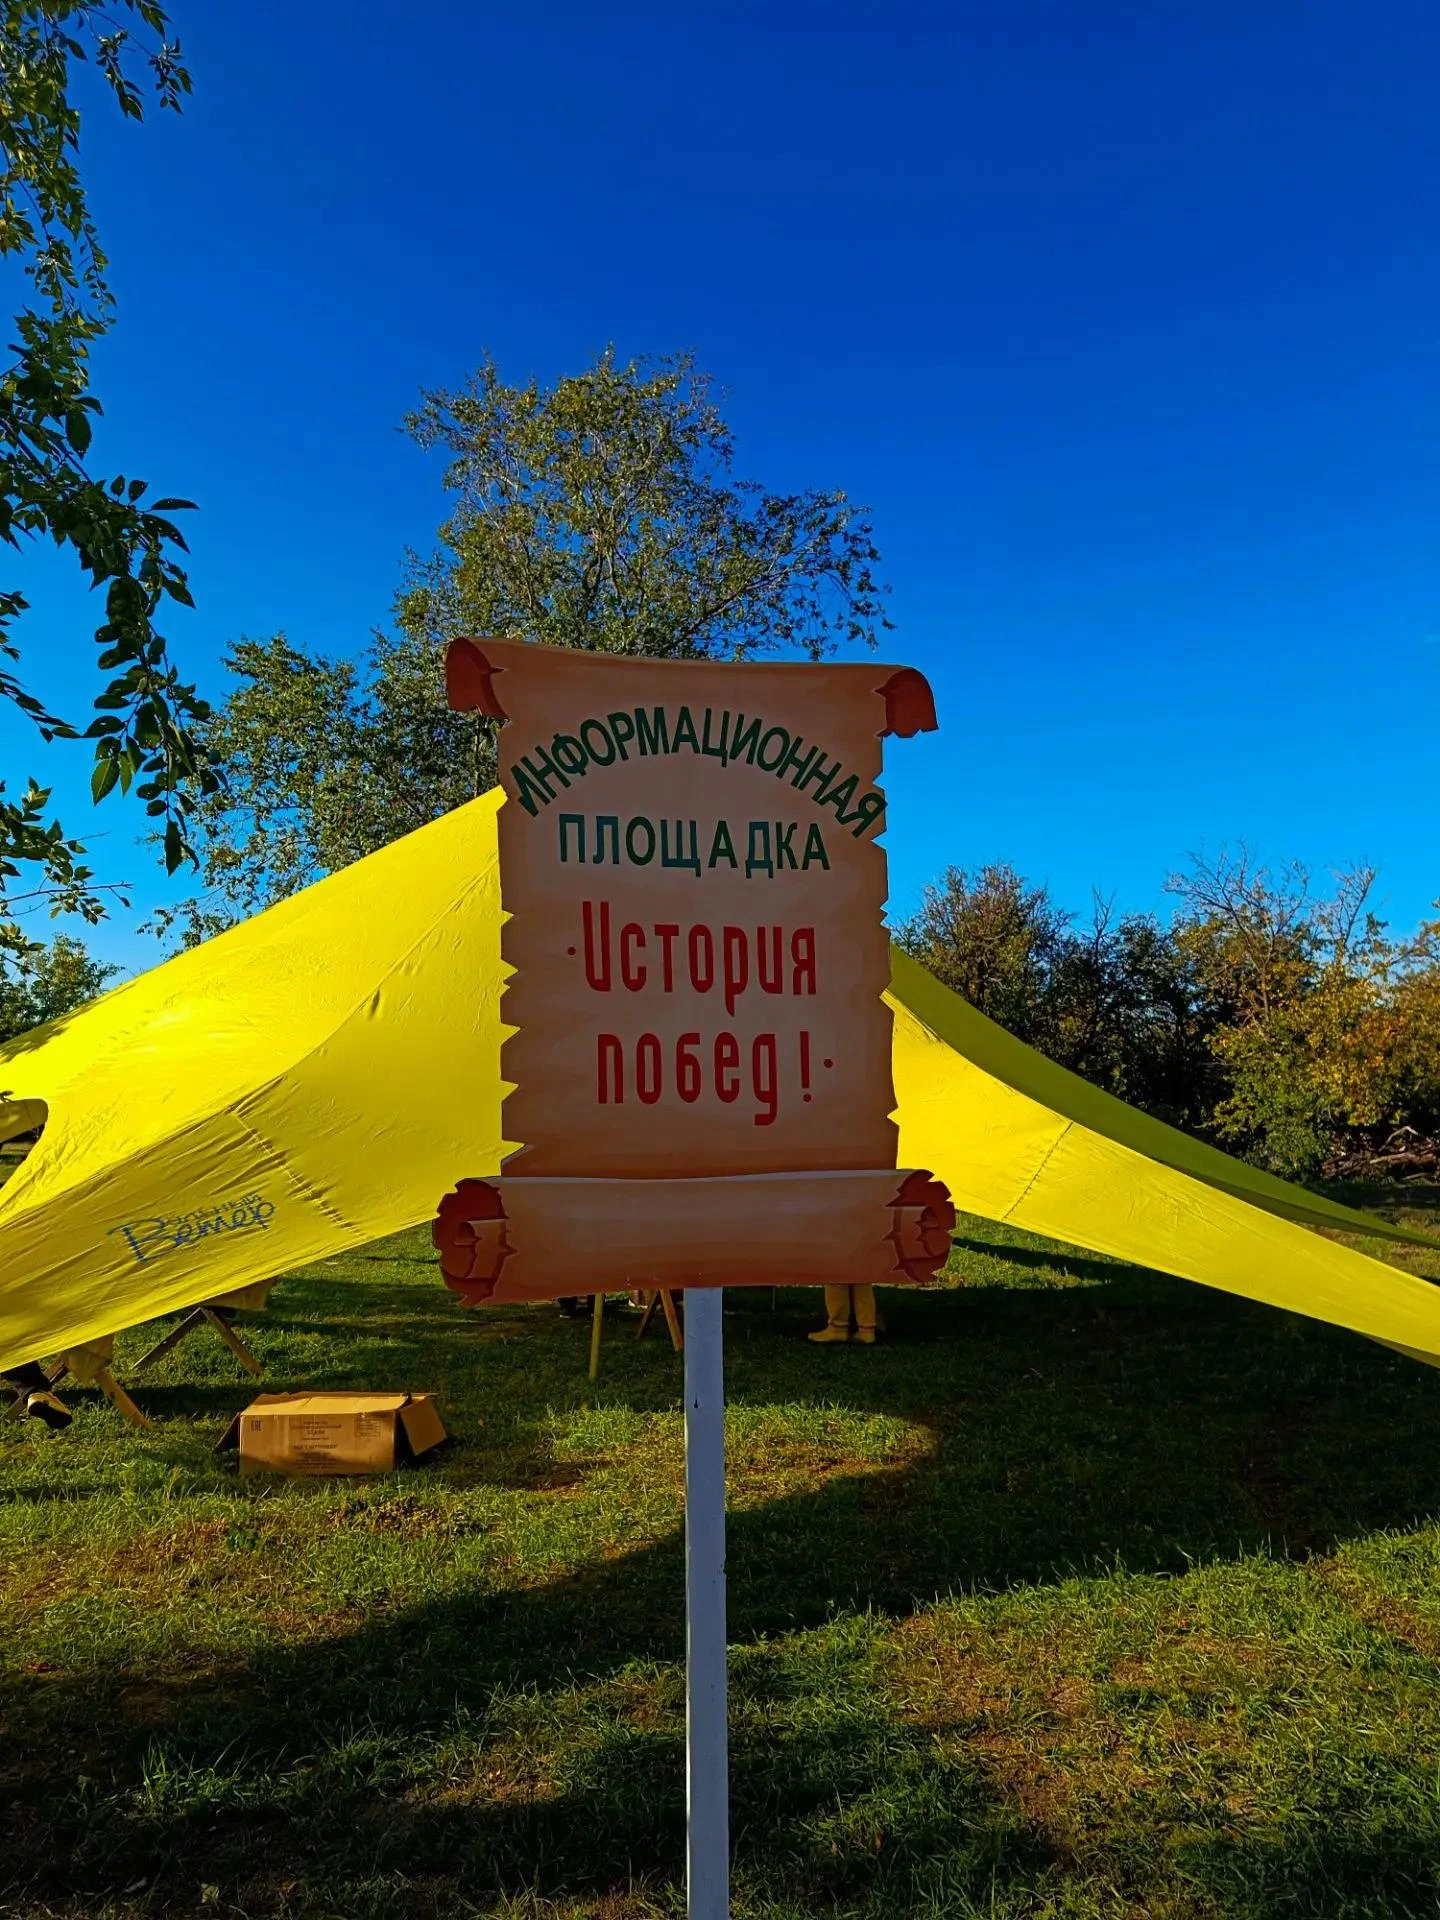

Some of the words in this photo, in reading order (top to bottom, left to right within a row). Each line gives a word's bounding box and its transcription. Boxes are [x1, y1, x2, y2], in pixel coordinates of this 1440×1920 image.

[509, 705, 887, 839] ИНФОРМАЦИОННАЯ
[558, 813, 831, 879] ПЛОЩАДКА
[582, 900, 817, 1018] История
[107, 1201, 276, 1263] Ветер
